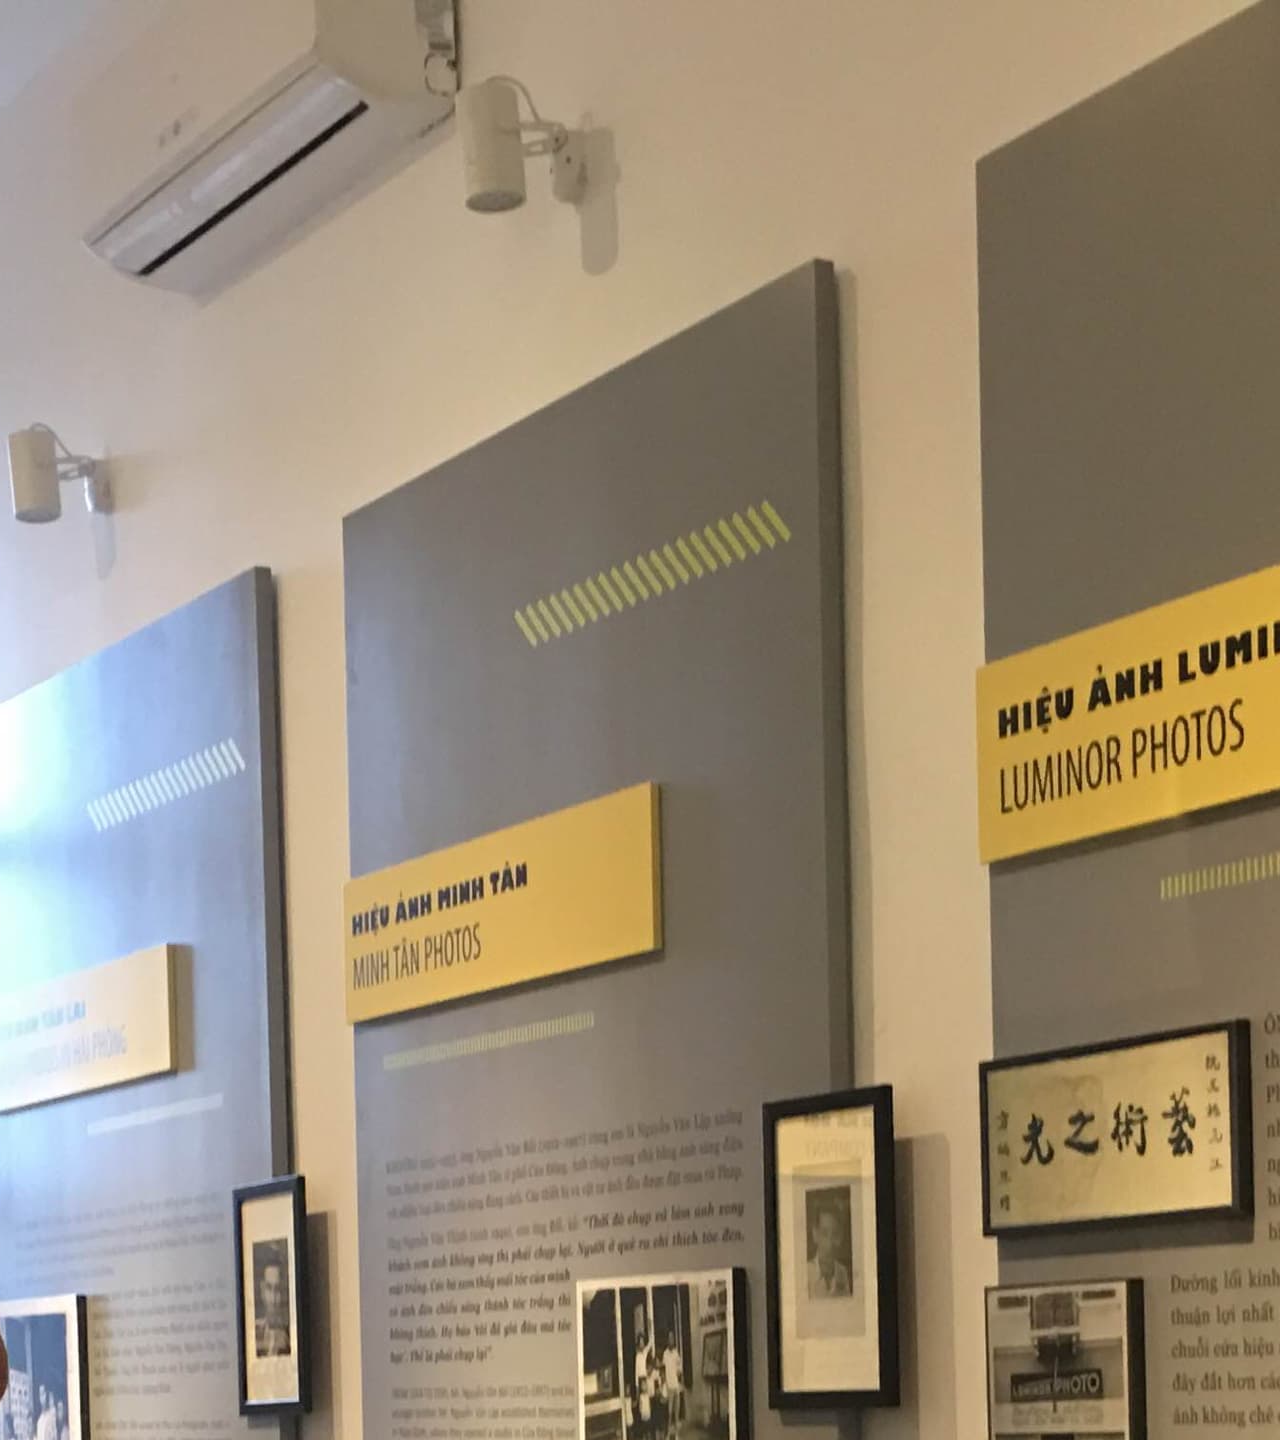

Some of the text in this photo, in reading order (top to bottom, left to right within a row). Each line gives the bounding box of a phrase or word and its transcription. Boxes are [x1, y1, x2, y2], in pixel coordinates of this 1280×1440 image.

[998, 686, 1074, 739] HIỆU
[1088, 660, 1163, 712] ẢNH
[999, 698, 1245, 814] LUMINOR PHOTOS
[352, 861, 528, 937] HIỆU ẢNH MINH TÂN
[353, 950, 390, 990] MINH
[425, 922, 481, 972] PHOTOS
